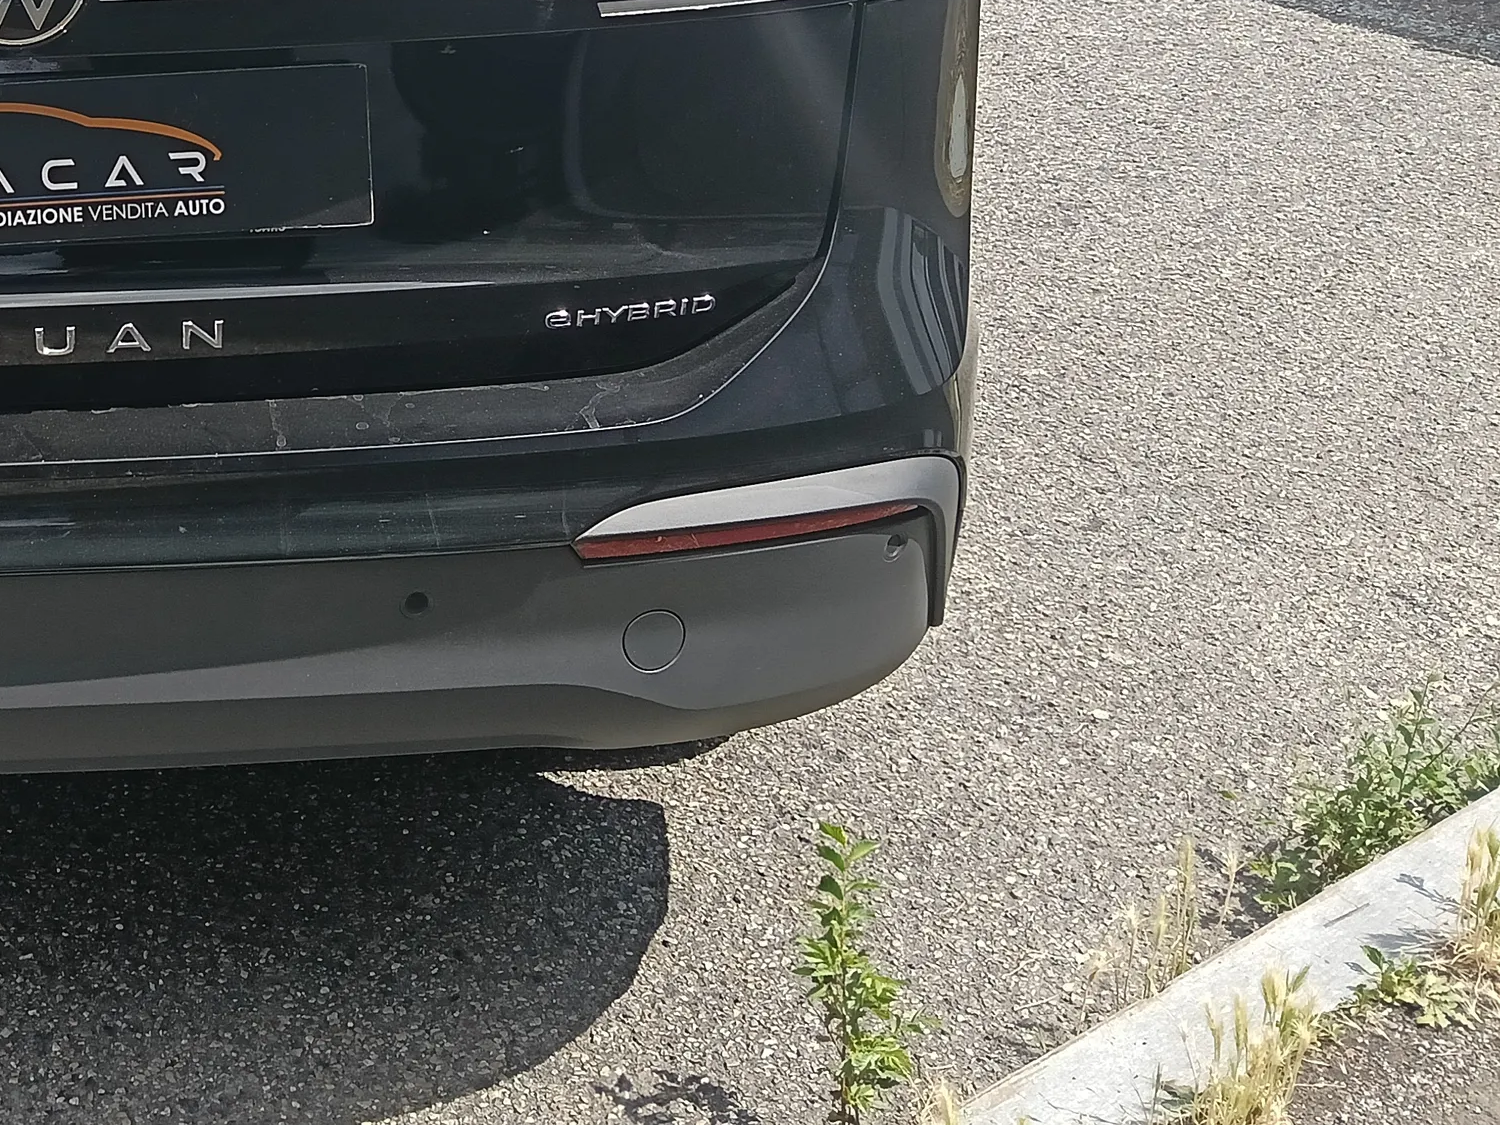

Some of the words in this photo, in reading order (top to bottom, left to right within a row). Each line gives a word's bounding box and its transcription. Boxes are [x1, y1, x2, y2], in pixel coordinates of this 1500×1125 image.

[88, 201, 169, 222] VENDITA
[174, 198, 226, 217] AUTO
[545, 293, 716, 329] eHYBRID
